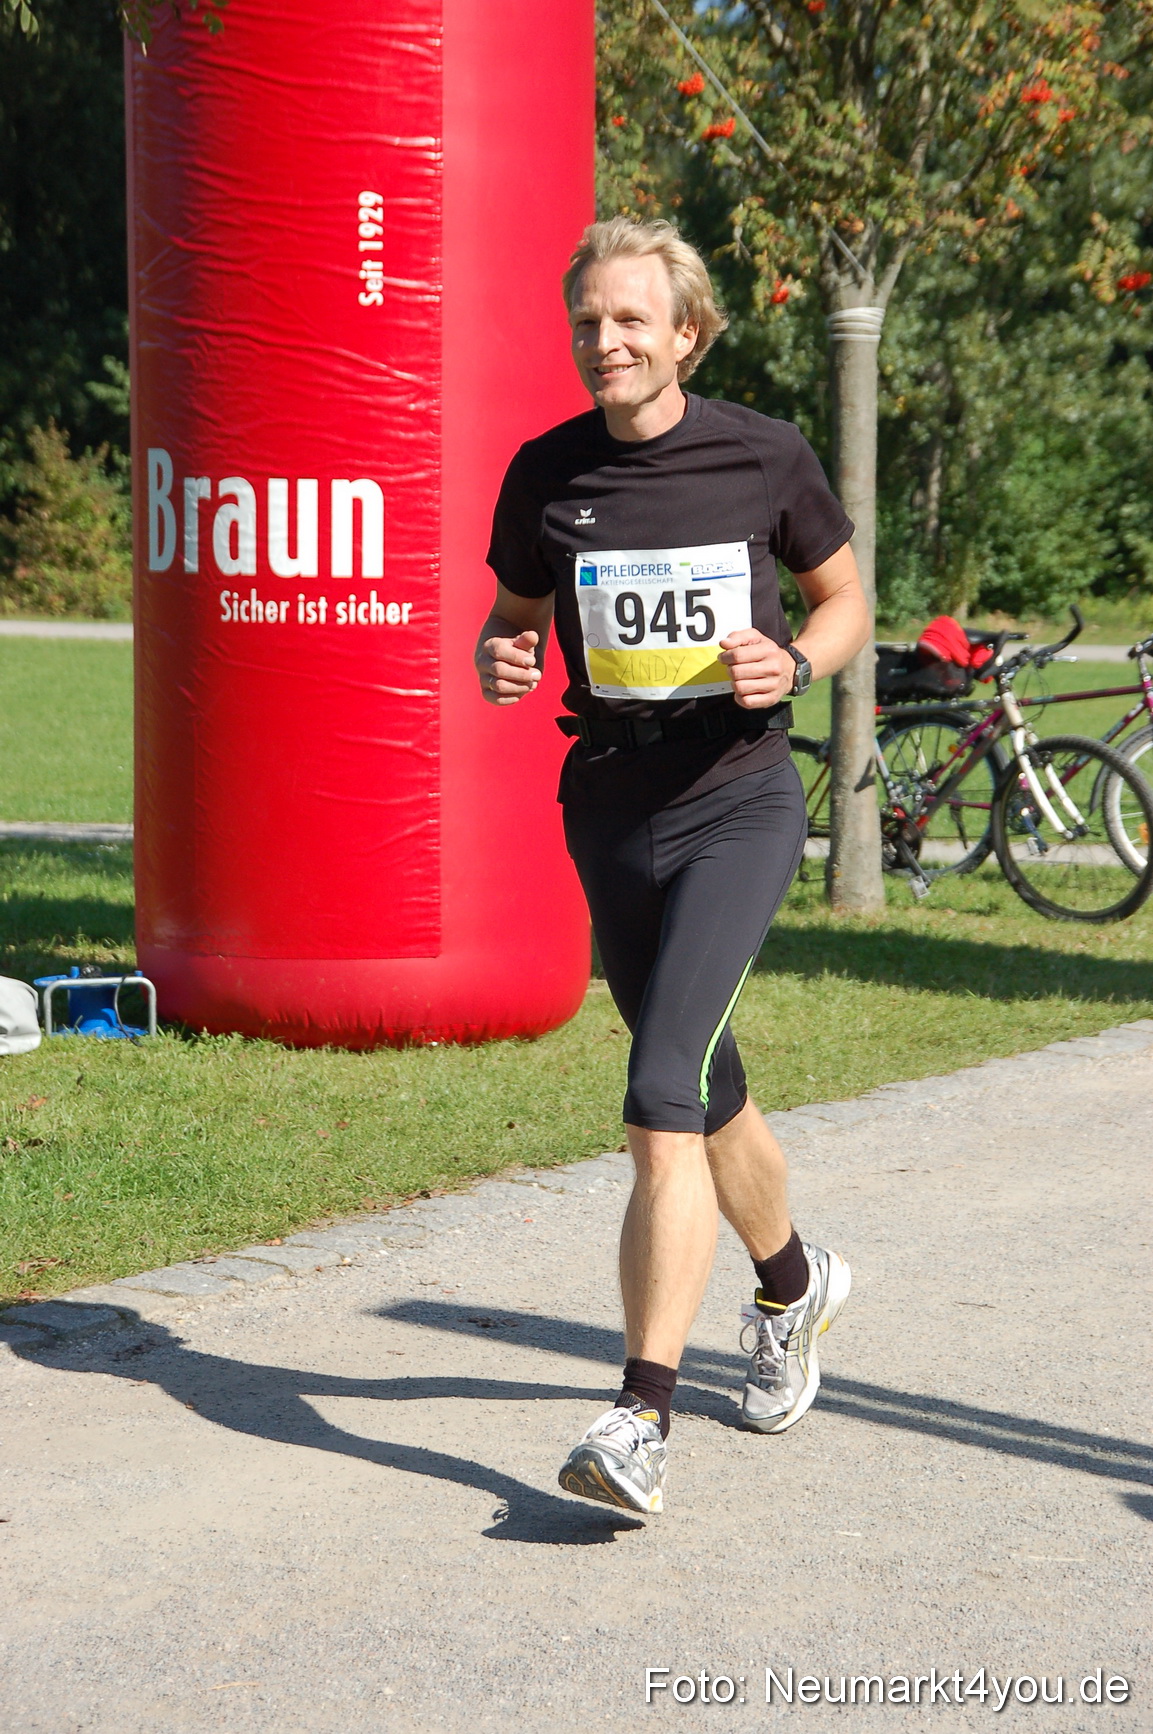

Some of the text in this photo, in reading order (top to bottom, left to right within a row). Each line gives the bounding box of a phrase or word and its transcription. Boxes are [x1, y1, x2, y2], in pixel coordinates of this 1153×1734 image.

[358, 190, 384, 307] Seit 1929
[147, 447, 385, 579] Braun
[600, 563, 673, 578] PFLEIDERER
[601, 577, 674, 586] AKTIENGESELLSCHAFT
[220, 588, 413, 626] Sicher ist sicher
[614, 588, 716, 645] 945
[619, 654, 686, 684] ANDY
